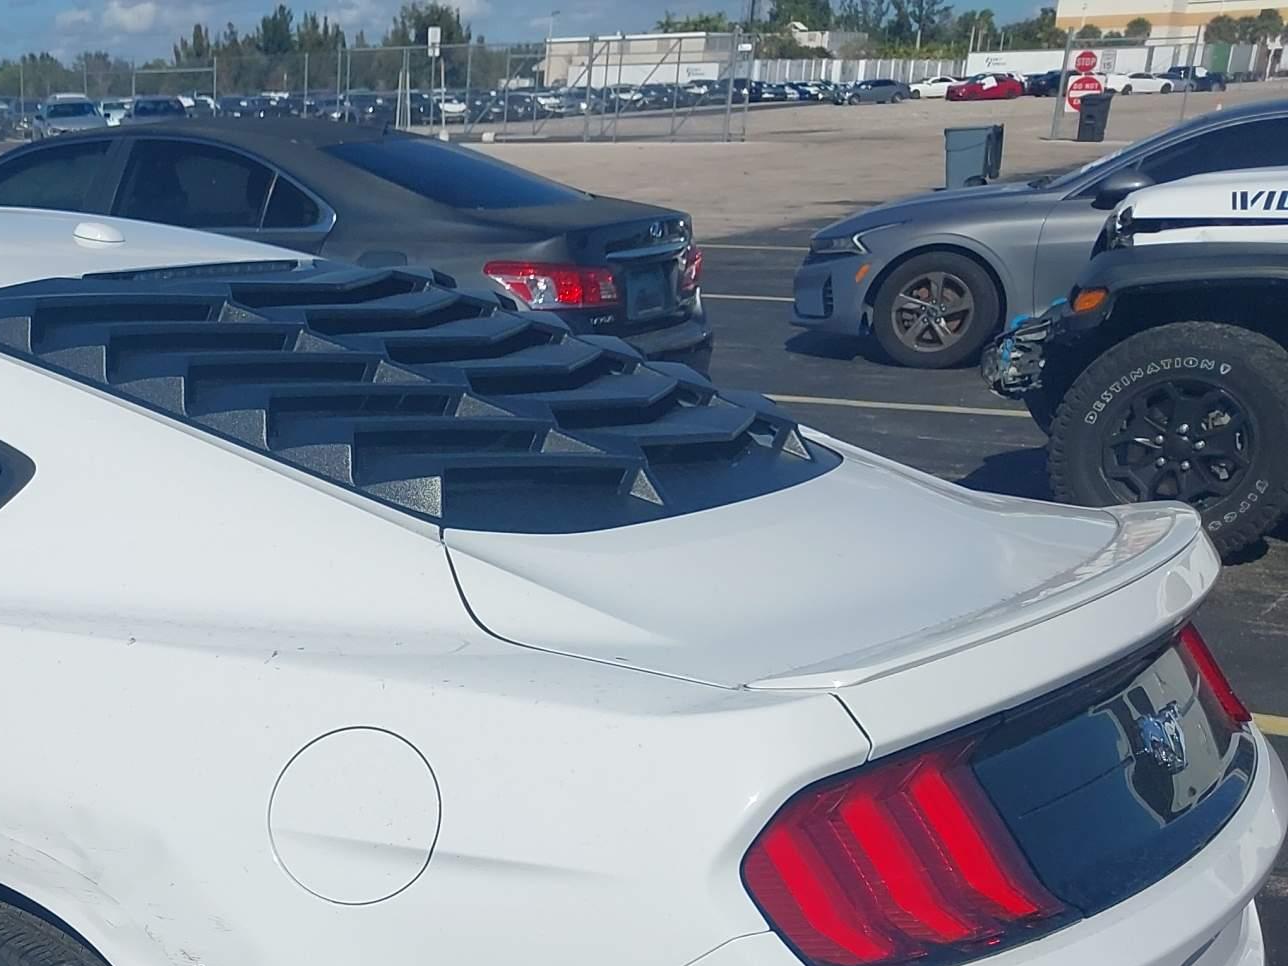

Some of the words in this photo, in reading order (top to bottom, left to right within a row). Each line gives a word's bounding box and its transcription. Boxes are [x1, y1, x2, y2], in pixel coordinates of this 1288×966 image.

[1076, 57, 1097, 67] STOP
[1072, 82, 1083, 90] DO
[1084, 82, 1099, 90] NOT
[1084, 356, 1216, 425] DESTINATION
